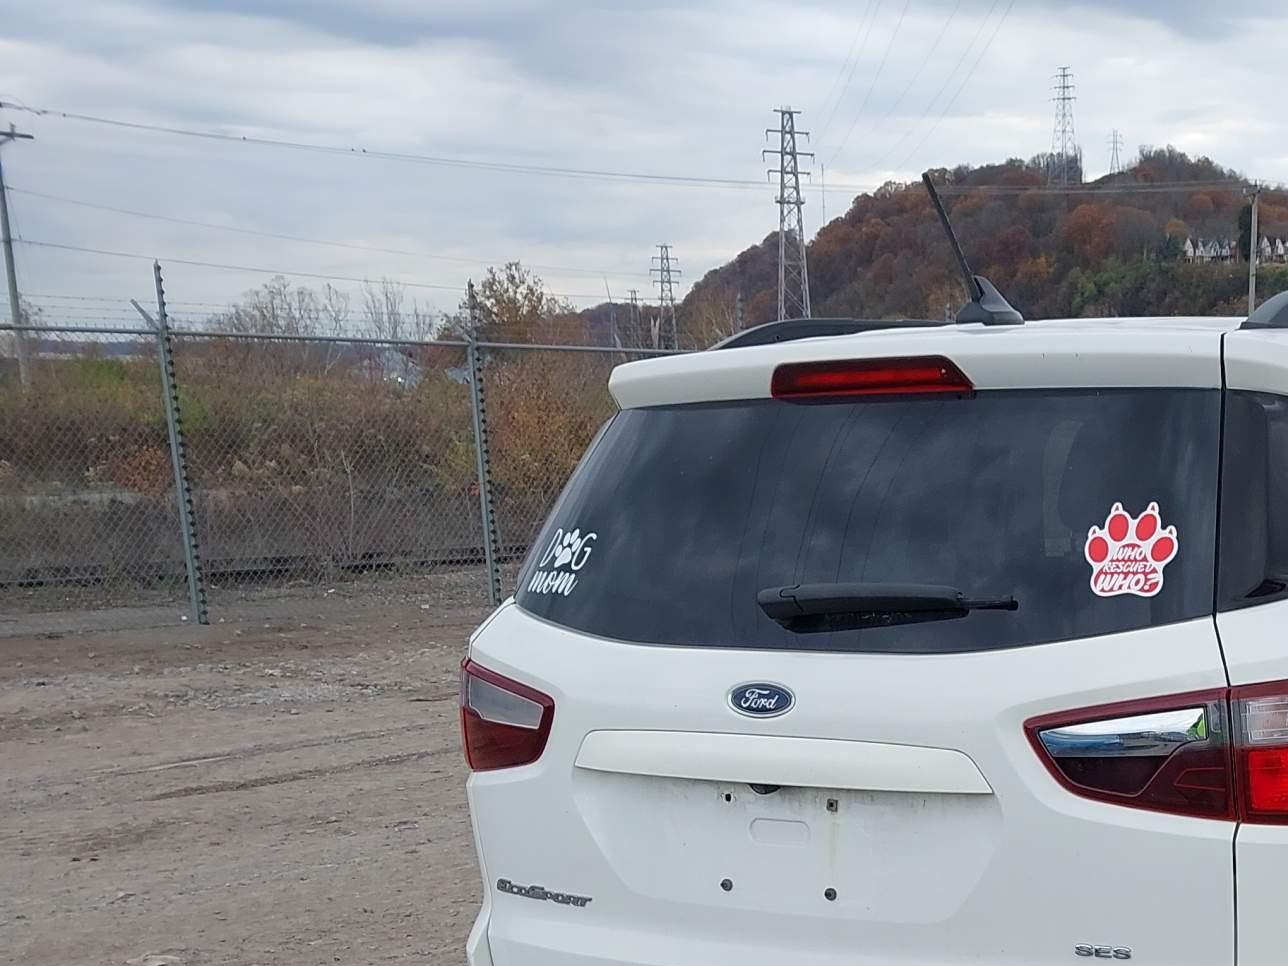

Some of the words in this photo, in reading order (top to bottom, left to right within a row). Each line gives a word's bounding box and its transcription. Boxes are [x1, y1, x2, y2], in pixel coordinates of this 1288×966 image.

[1113, 546, 1145, 561] WHO
[1103, 561, 1154, 573] RESCUED
[528, 571, 578, 596] mom
[1097, 573, 1161, 591] WHO?
[741, 688, 779, 709] Ford
[1074, 943, 1132, 960] SES
